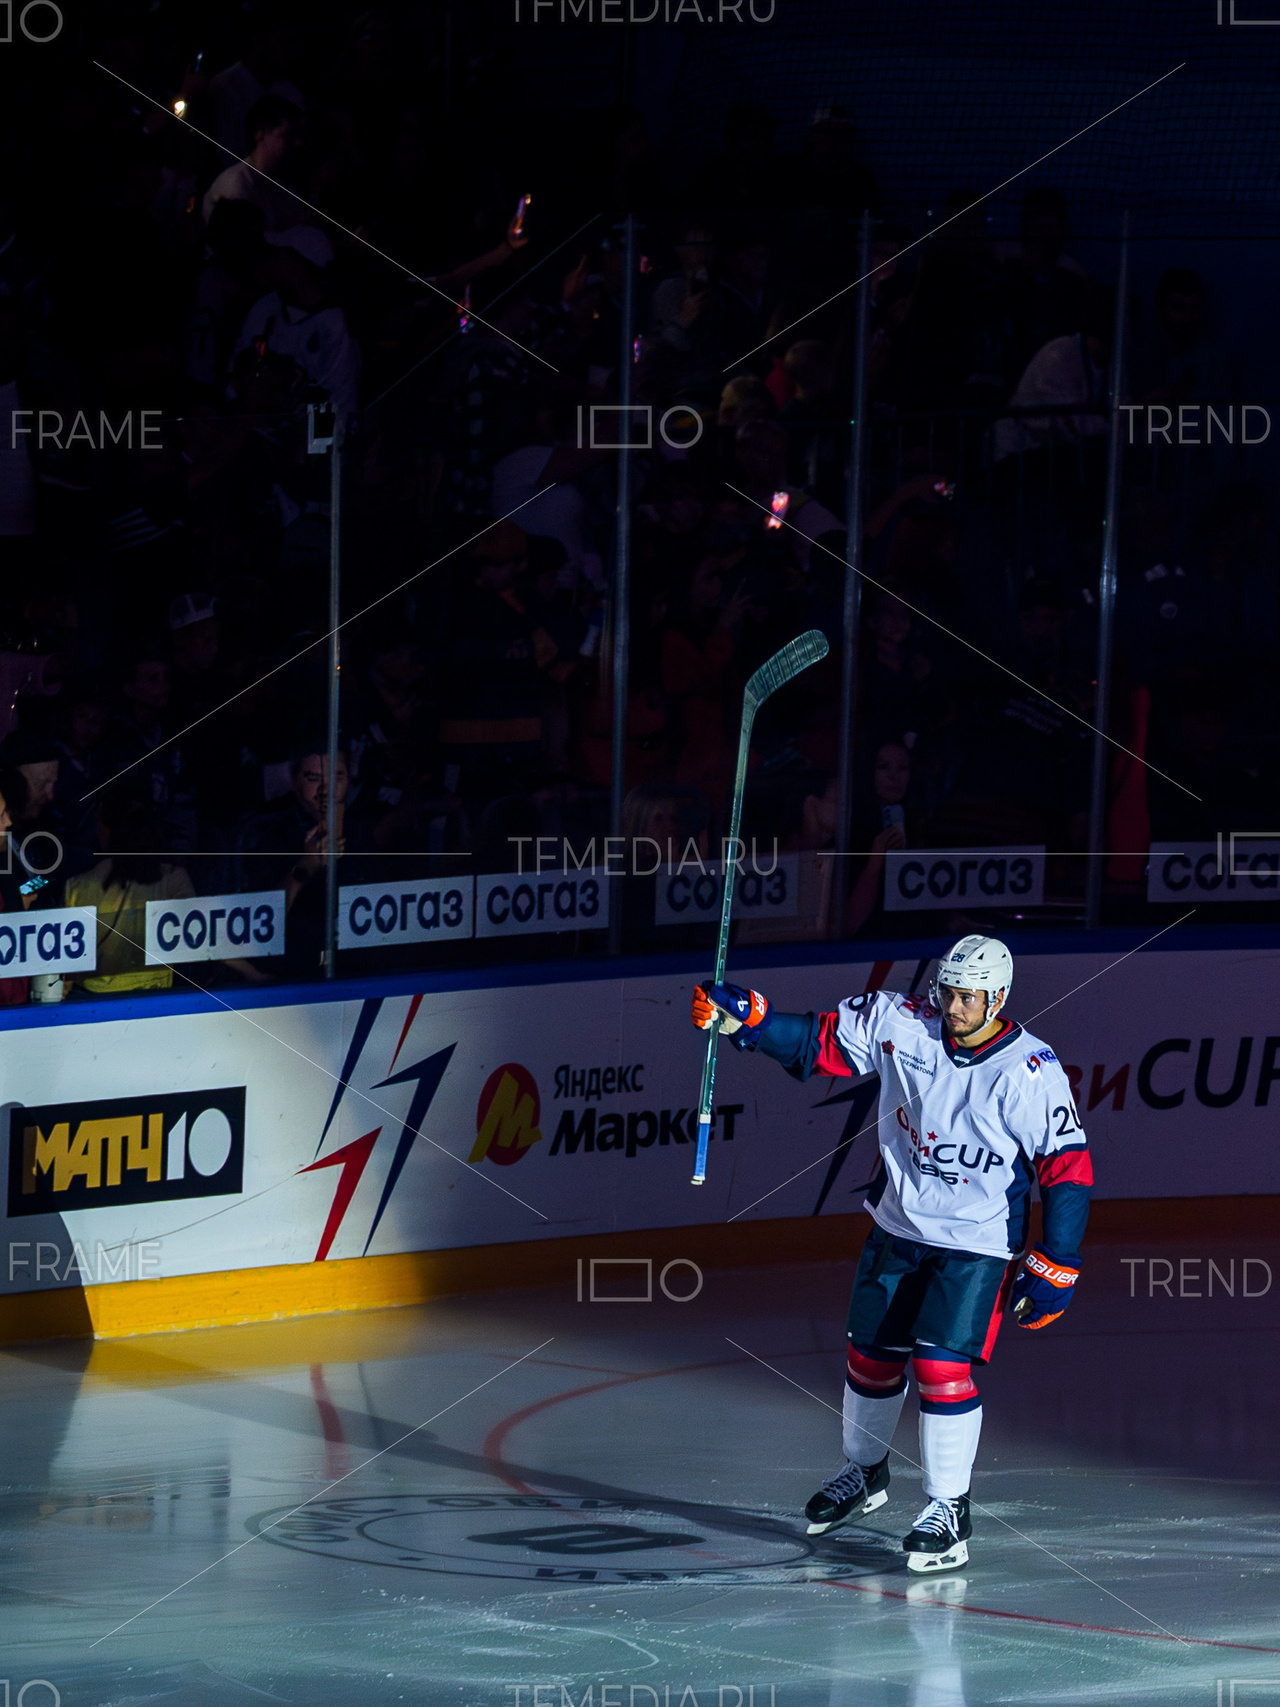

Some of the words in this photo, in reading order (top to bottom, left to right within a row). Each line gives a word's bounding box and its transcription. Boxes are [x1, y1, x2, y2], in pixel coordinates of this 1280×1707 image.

[0, 920, 85, 965] огаз
[951, 953, 965, 962] 28
[554, 1064, 644, 1100] Яндекс
